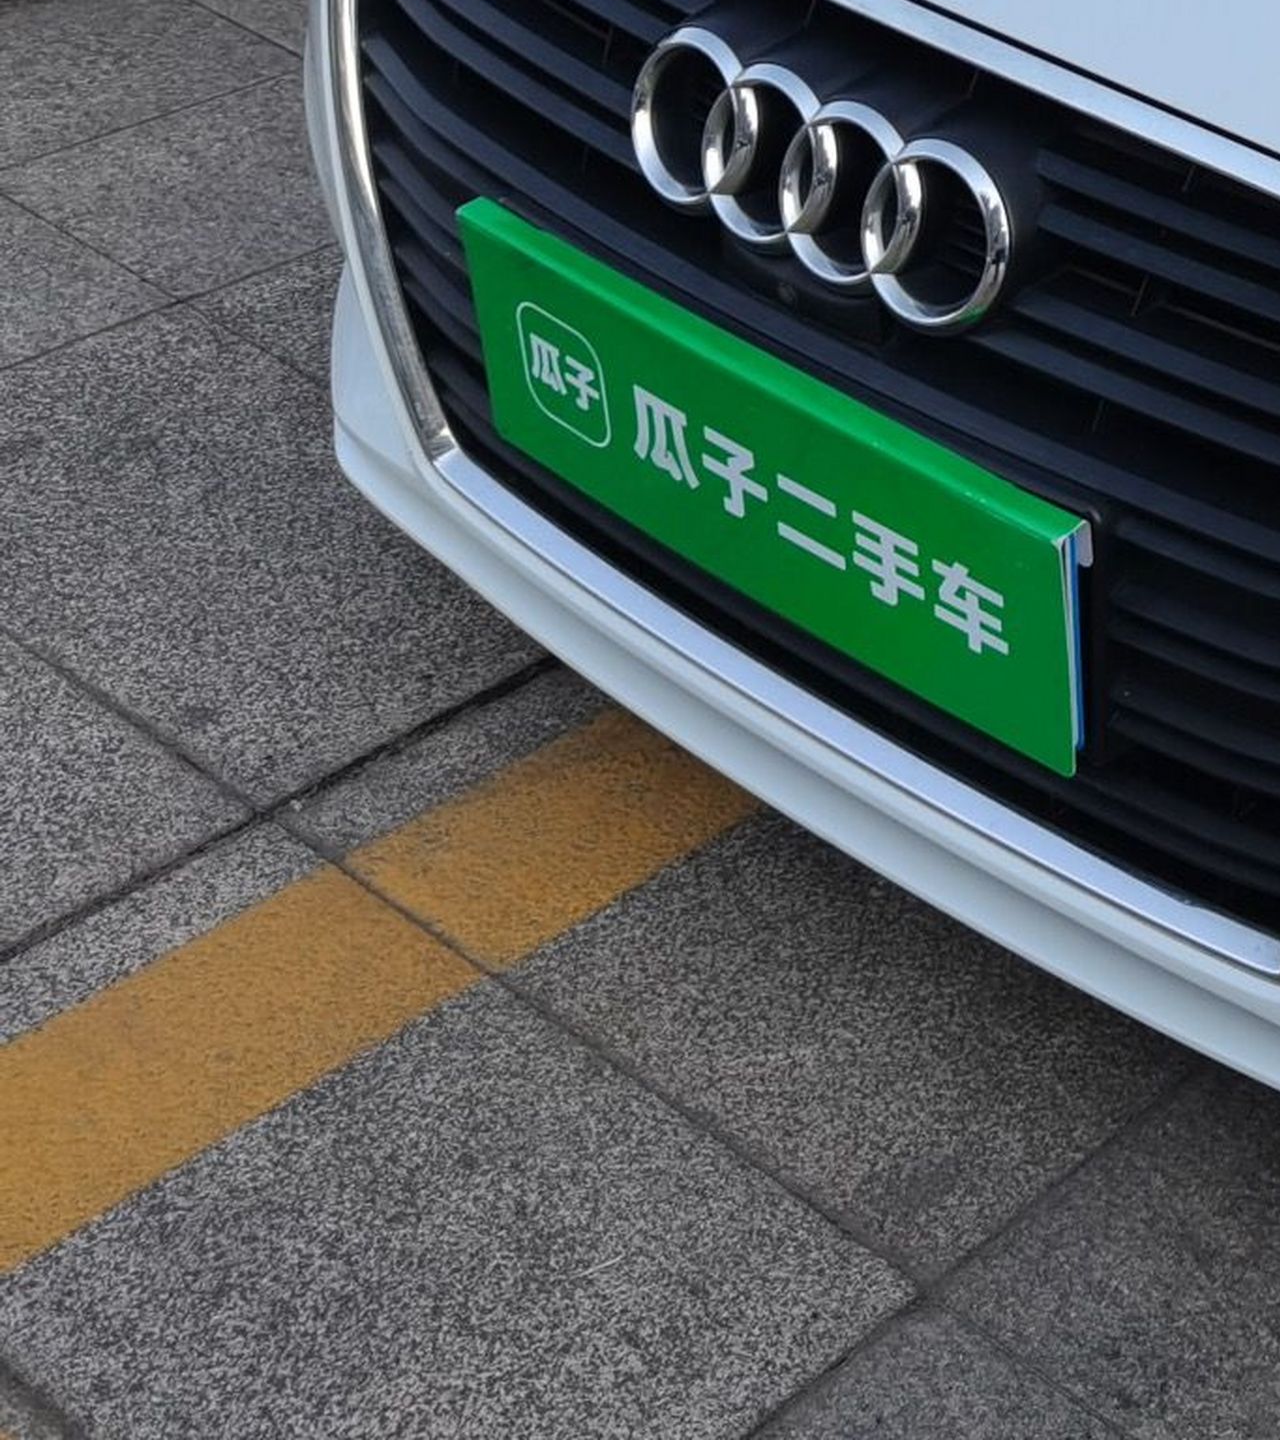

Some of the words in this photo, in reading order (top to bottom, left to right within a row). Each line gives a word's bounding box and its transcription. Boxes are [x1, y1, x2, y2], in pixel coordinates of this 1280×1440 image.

[529, 332, 601, 413] 瓜子
[632, 384, 1010, 657] 瓜子二手车
